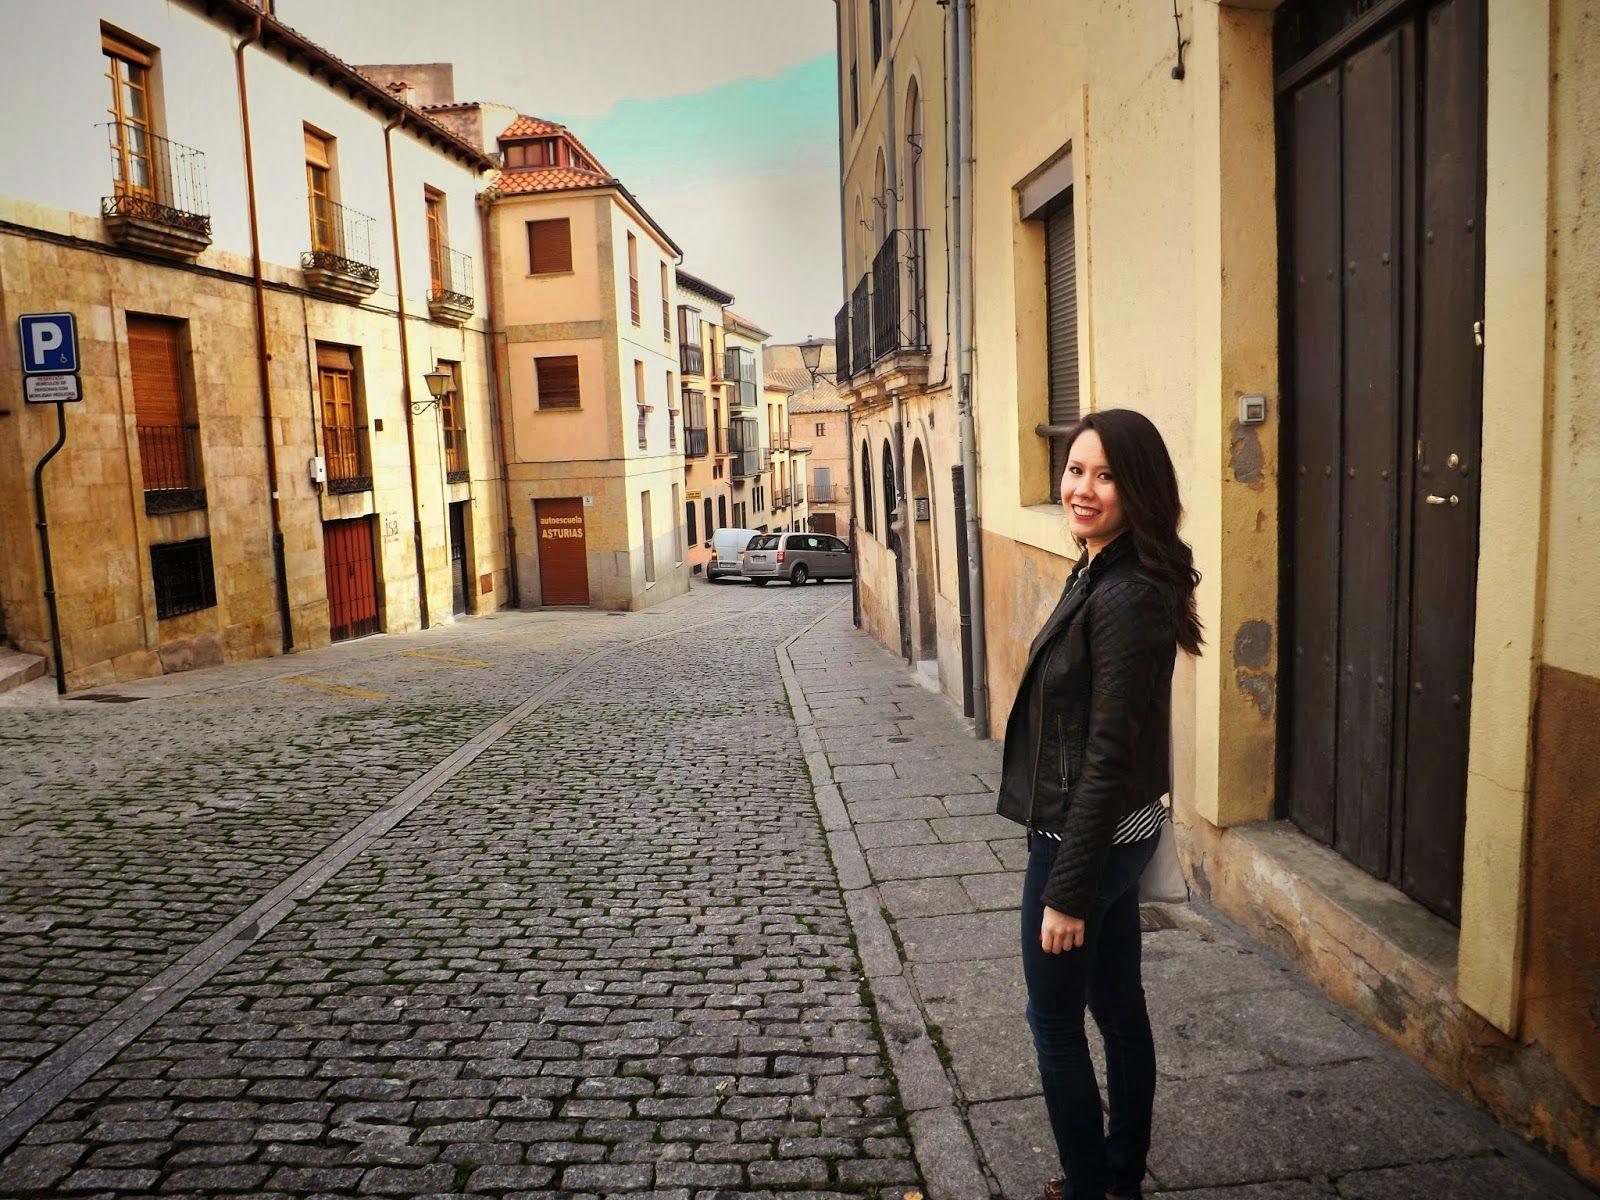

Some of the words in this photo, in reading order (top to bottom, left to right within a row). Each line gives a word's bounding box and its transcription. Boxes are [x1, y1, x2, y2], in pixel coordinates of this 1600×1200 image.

[31, 322, 62, 364] P
[540, 516, 582, 524] autoescuela
[542, 528, 583, 539] ASTURIAS
